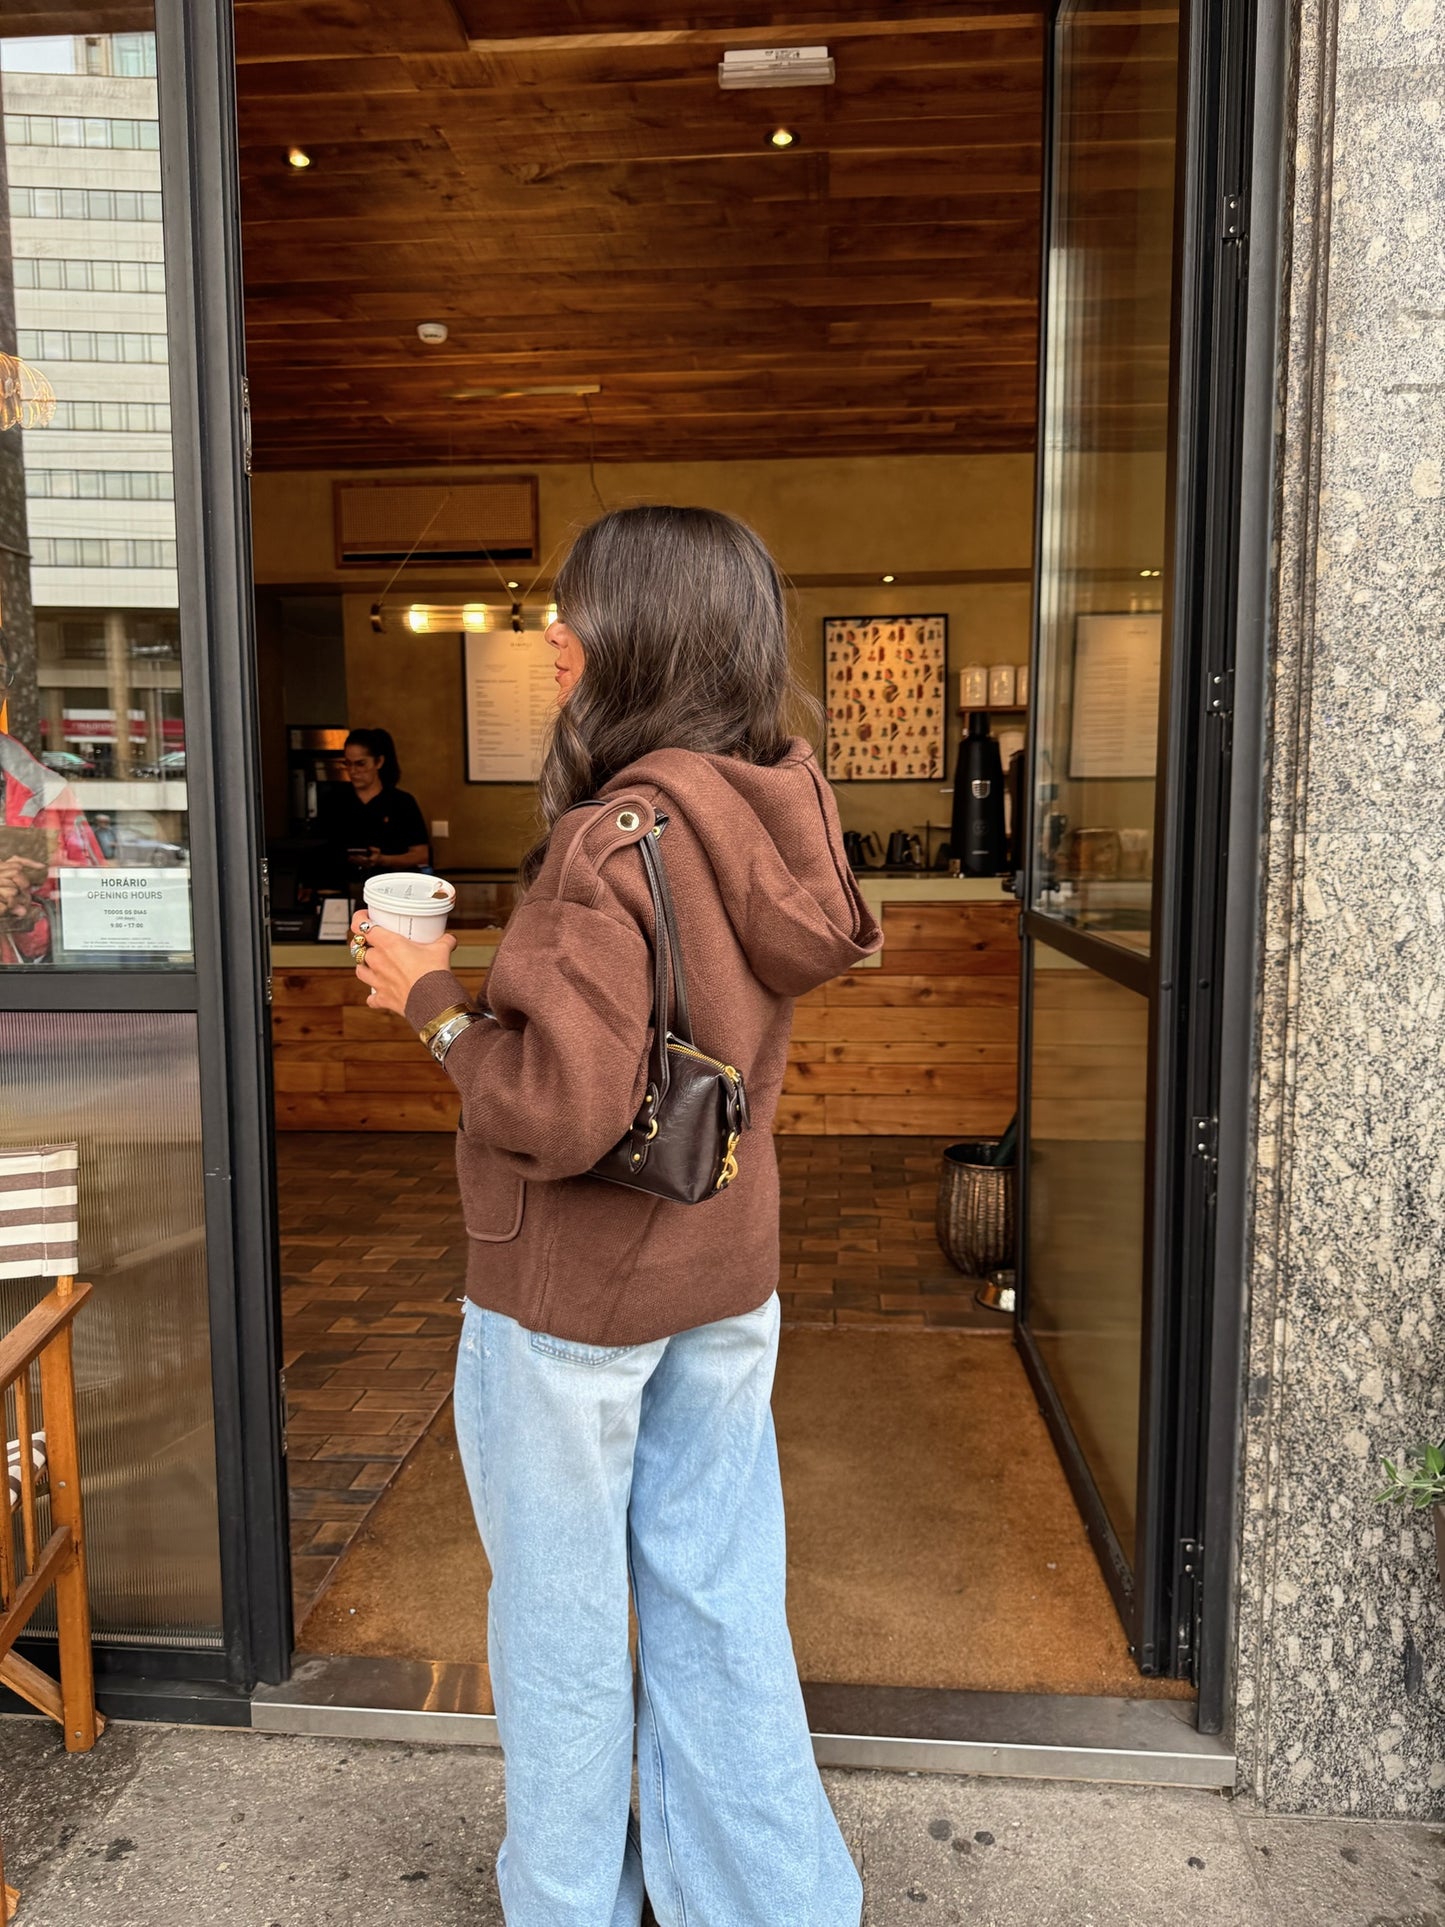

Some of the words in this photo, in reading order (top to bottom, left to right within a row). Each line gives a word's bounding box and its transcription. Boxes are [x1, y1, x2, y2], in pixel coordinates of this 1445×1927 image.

[101, 877, 147, 887] HORÁRIO
[88, 891, 128, 899] OPENING
[131, 891, 163, 899] HOURS
